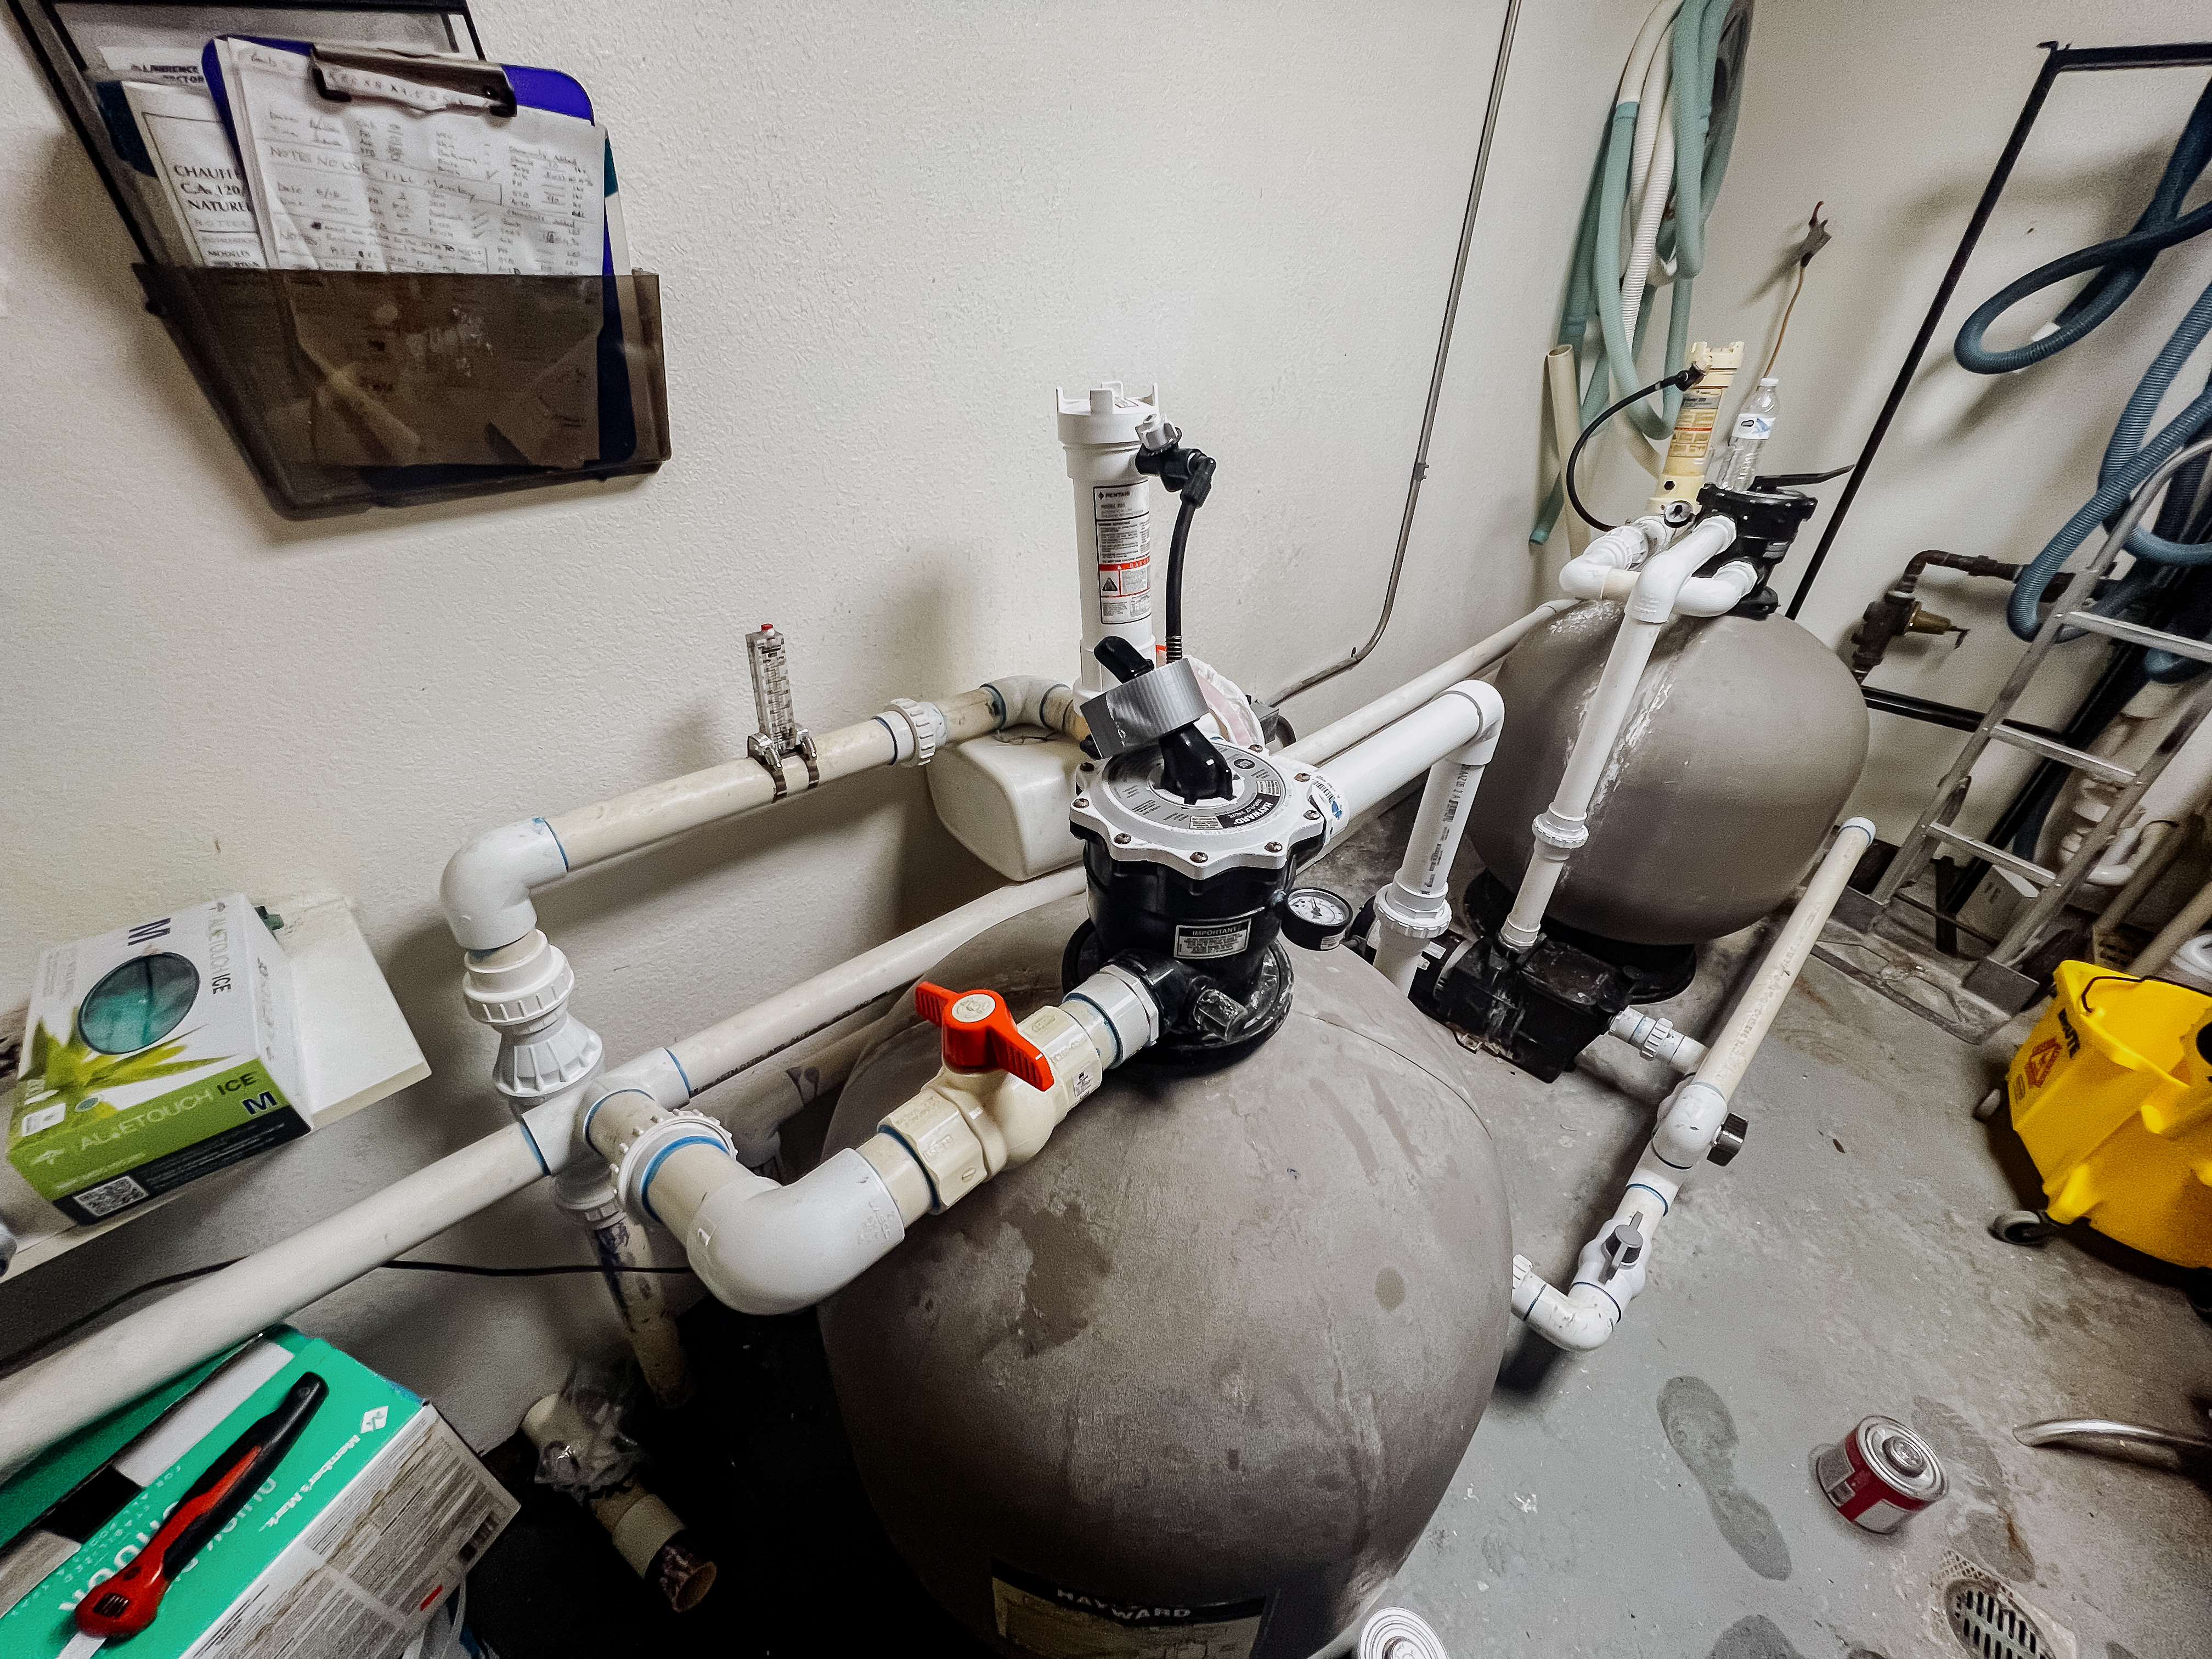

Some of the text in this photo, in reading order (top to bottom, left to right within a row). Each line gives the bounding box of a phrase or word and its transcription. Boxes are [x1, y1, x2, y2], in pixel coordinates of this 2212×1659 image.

[217, 1073, 257, 1096] ICE
[242, 1091, 276, 1115] M
[1057, 1589, 1191, 1620] HAYWARD
